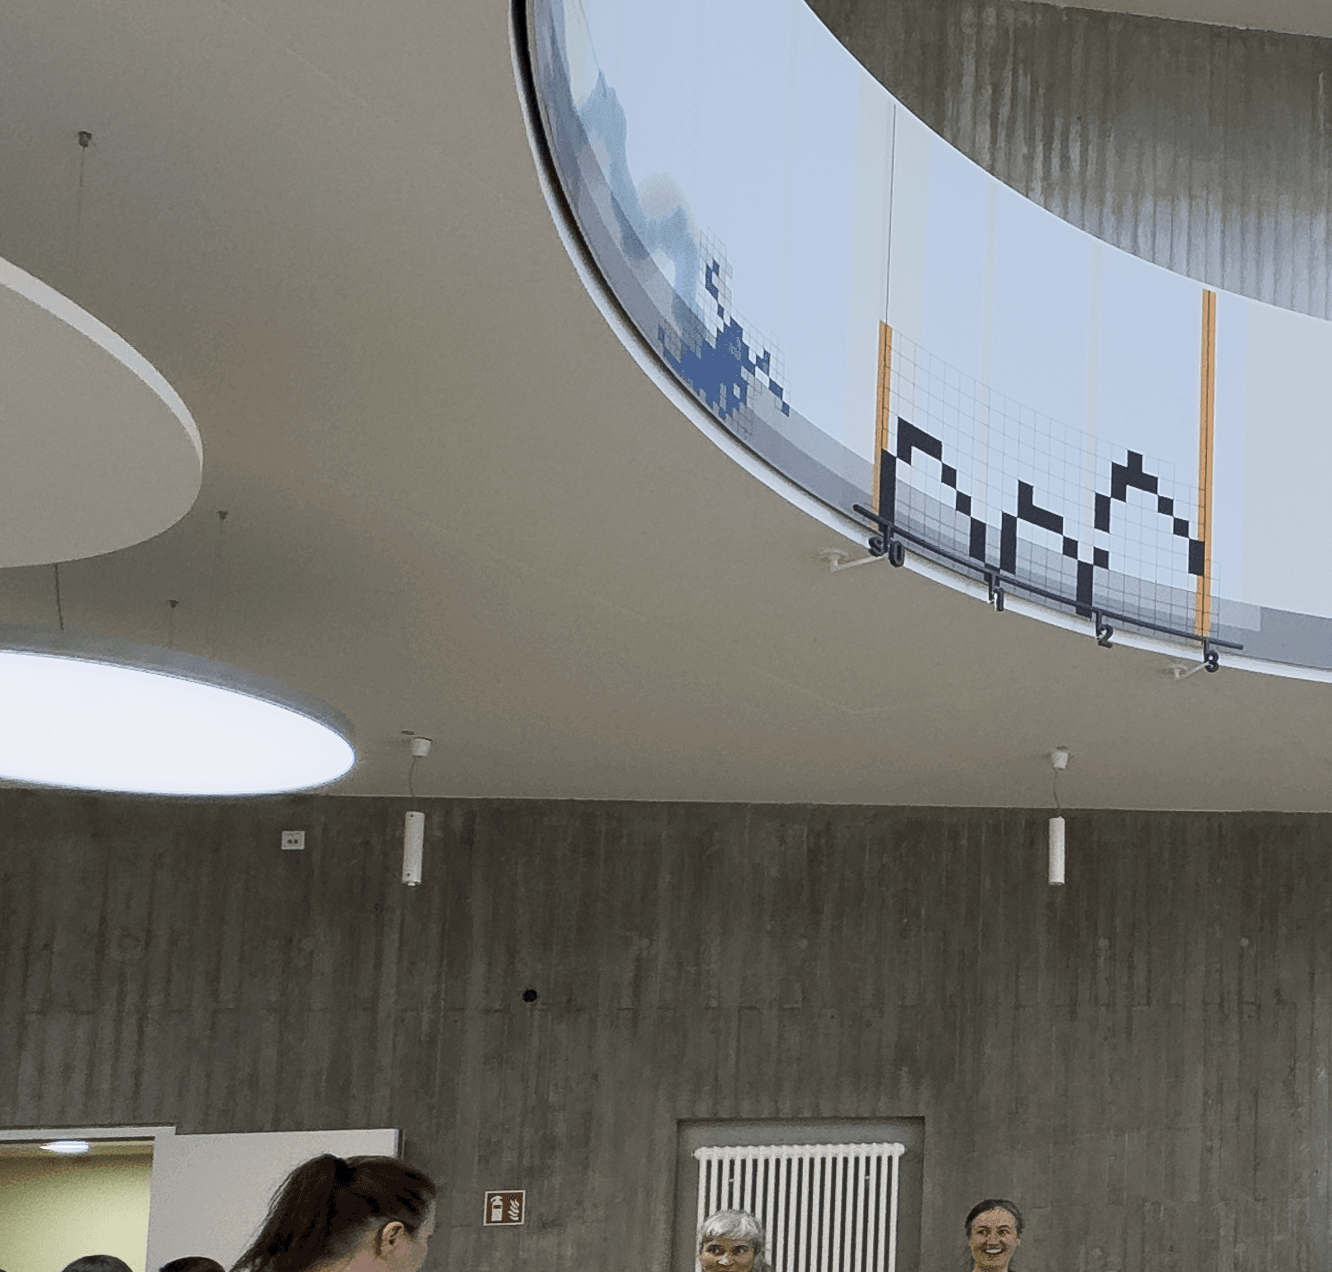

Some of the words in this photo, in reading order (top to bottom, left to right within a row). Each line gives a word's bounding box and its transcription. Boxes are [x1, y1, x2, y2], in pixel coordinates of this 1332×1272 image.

[888, 540, 905, 567] 0
[1097, 624, 1114, 648] 2
[1204, 650, 1219, 673] 3
